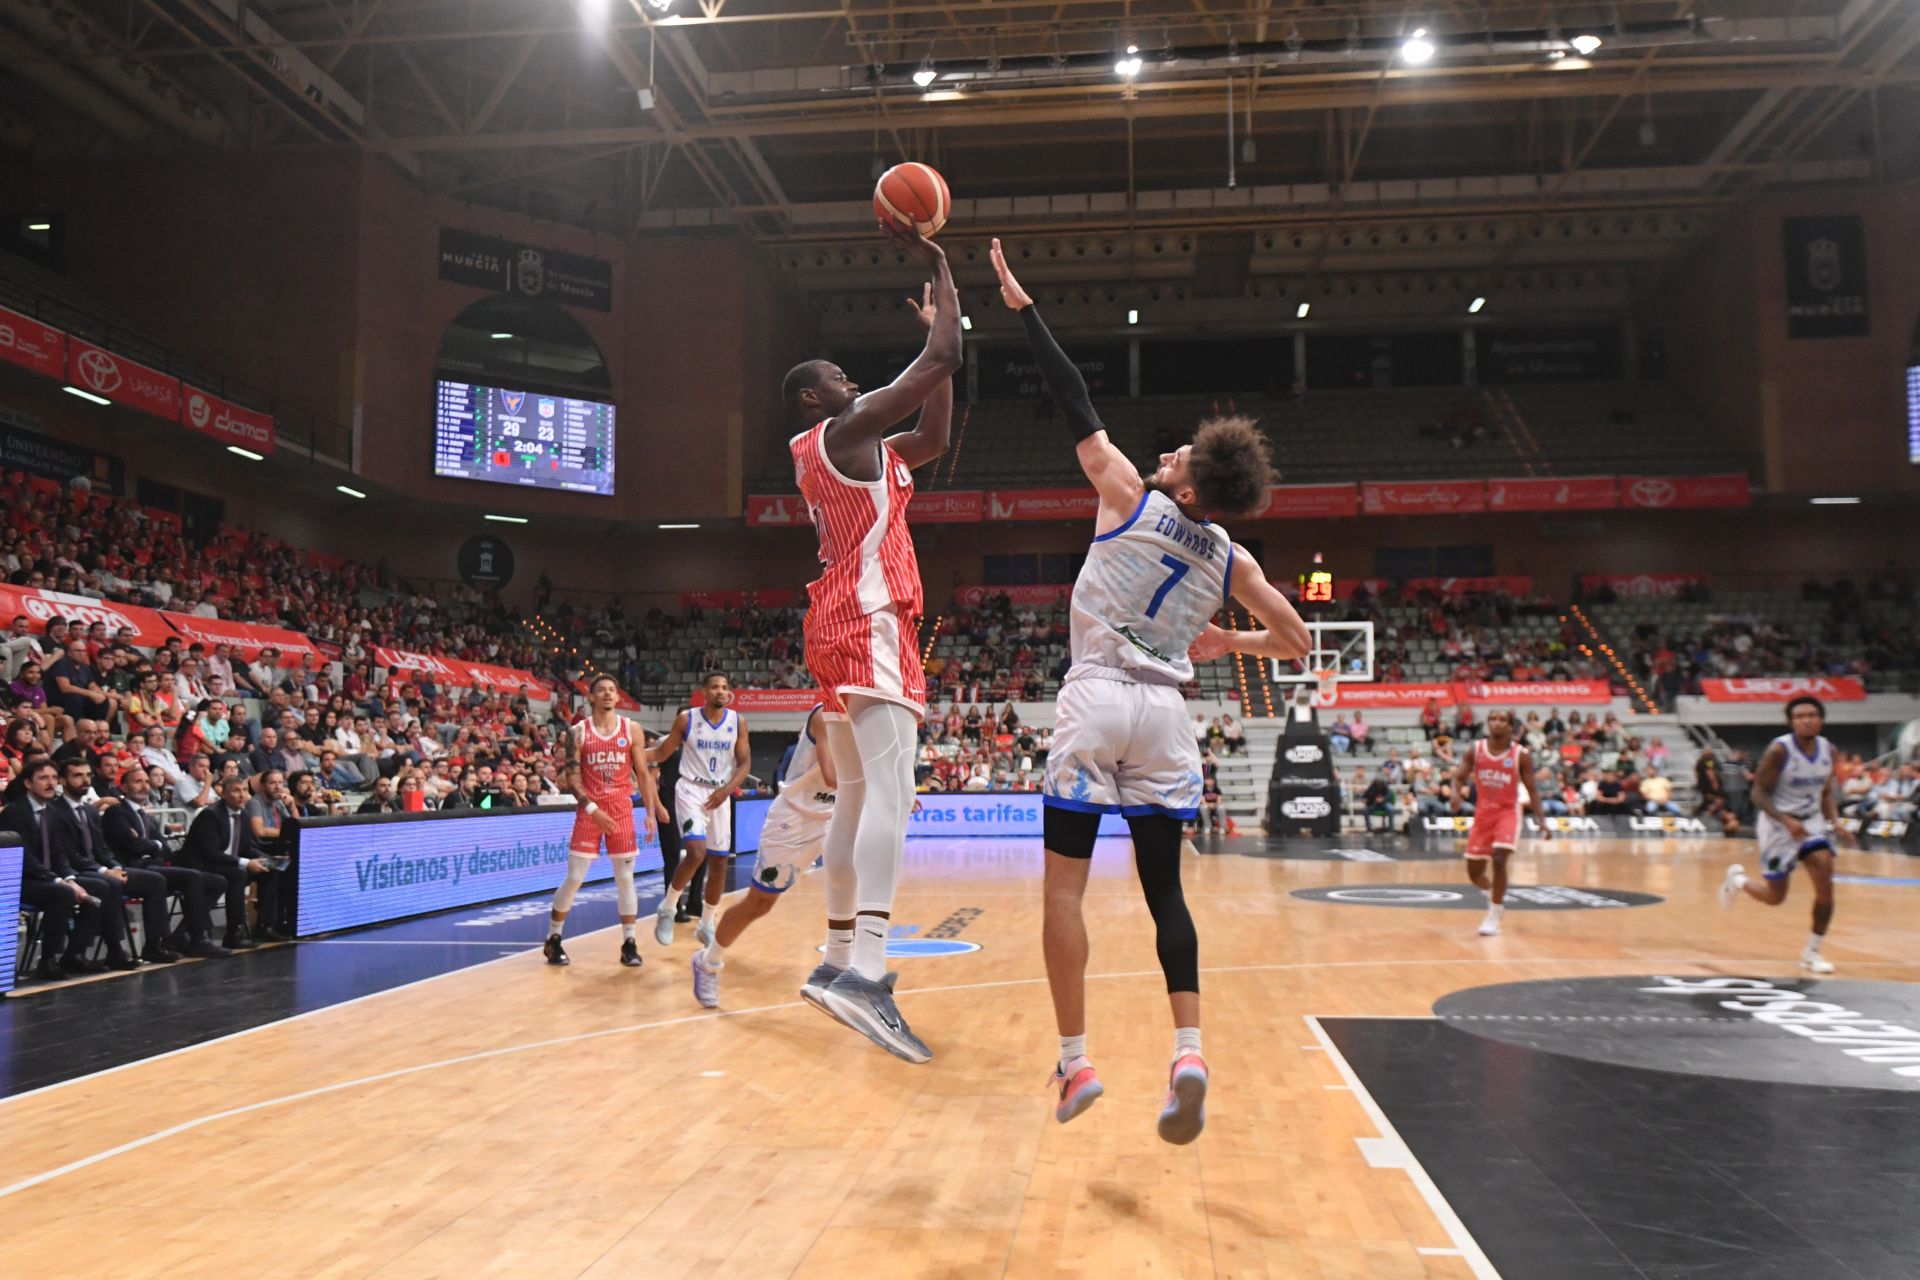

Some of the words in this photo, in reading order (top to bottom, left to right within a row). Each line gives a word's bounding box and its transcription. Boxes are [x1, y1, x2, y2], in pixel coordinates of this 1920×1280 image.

[1155, 514, 1216, 560] EDWARDS
[1144, 553, 1190, 620] 7
[758, 692, 816, 700] Soluciones
[1492, 685, 1591, 696] INMOKING
[586, 751, 627, 765] UCAM
[709, 756, 717, 772] 0
[963, 803, 1038, 823] tarifas
[356, 852, 450, 892] Visítanos
[452, 854, 464, 885] y
[468, 841, 540, 876] descubre
